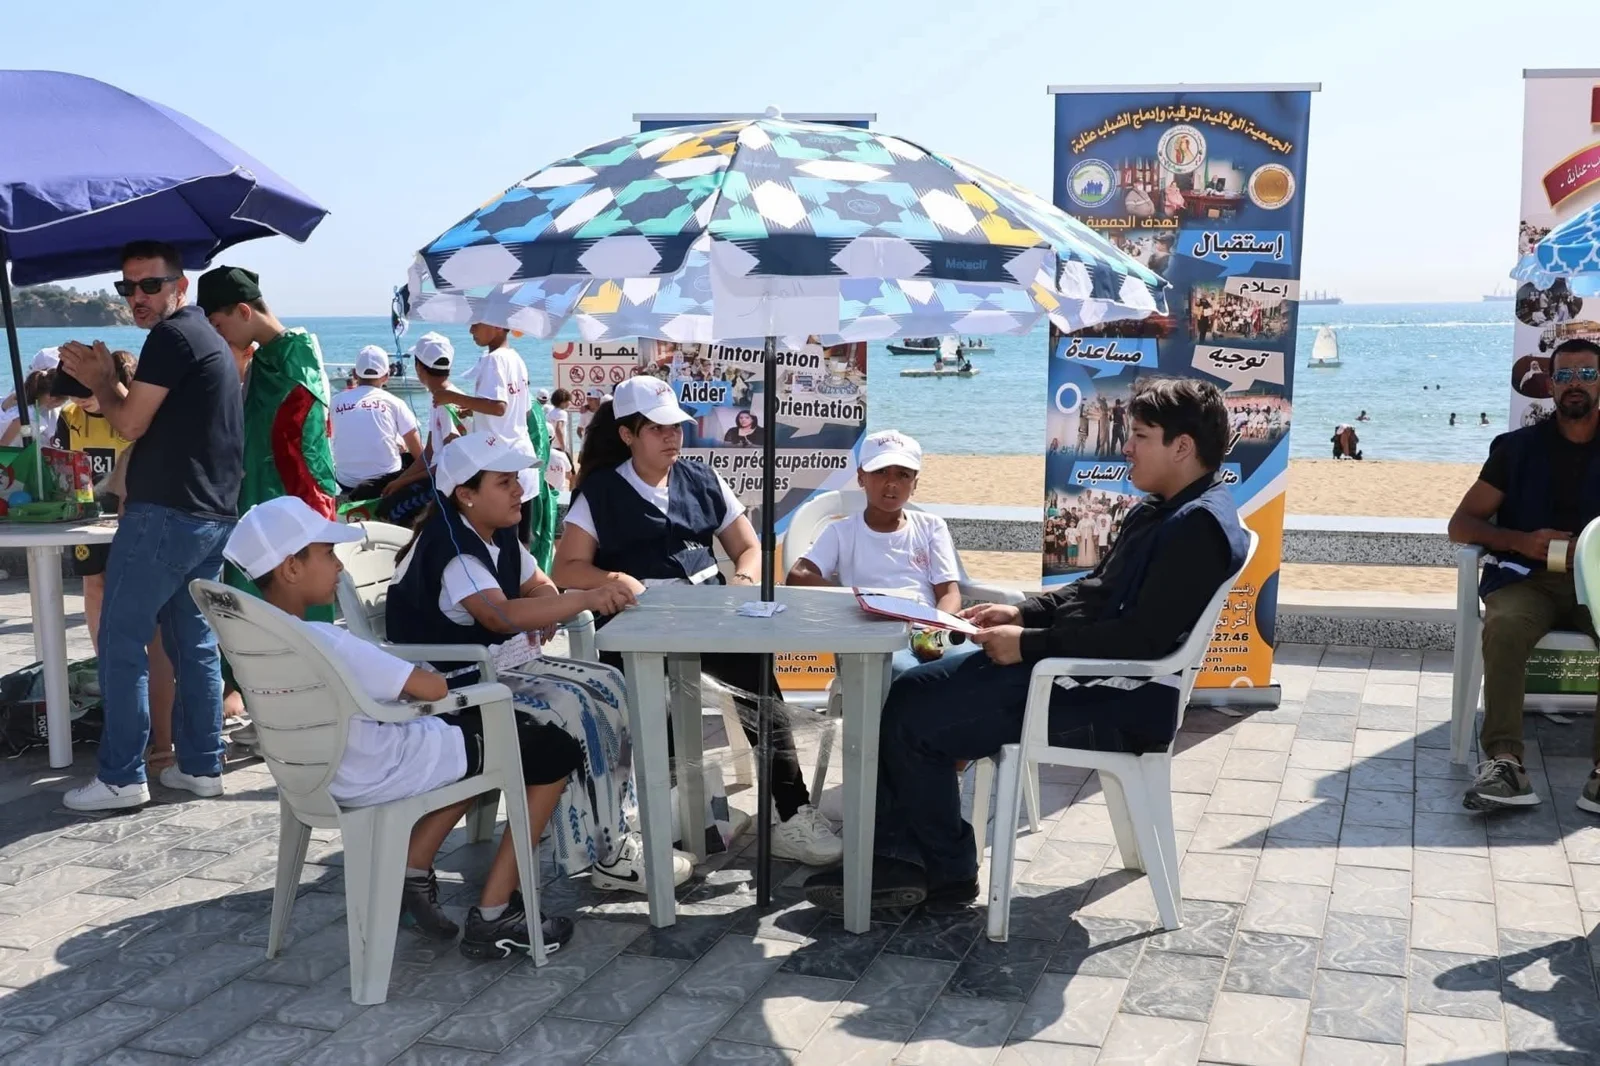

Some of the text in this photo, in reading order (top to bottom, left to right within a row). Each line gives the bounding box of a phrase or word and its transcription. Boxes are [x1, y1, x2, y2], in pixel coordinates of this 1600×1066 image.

[1167, 105, 1201, 122] لترقية
[1098, 112, 1131, 138] الشباب
[1071, 130, 1097, 154] عنابة
[1244, 122, 1293, 154] الجمعية
[1086, 216, 1136, 229] الجمعية
[1140, 216, 1179, 229] تهدف
[1194, 233, 1283, 259] إستقبال
[1065, 338, 1143, 363] مساعدة
[1208, 348, 1270, 371] توجيه
[680, 382, 726, 403] Aider
[361, 400, 387, 413] ولاية
[709, 451, 729, 469] les
[738, 473, 790, 494] jeues
[1076, 466, 1125, 485] الشباب
[775, 653, 817, 661] ail.com
